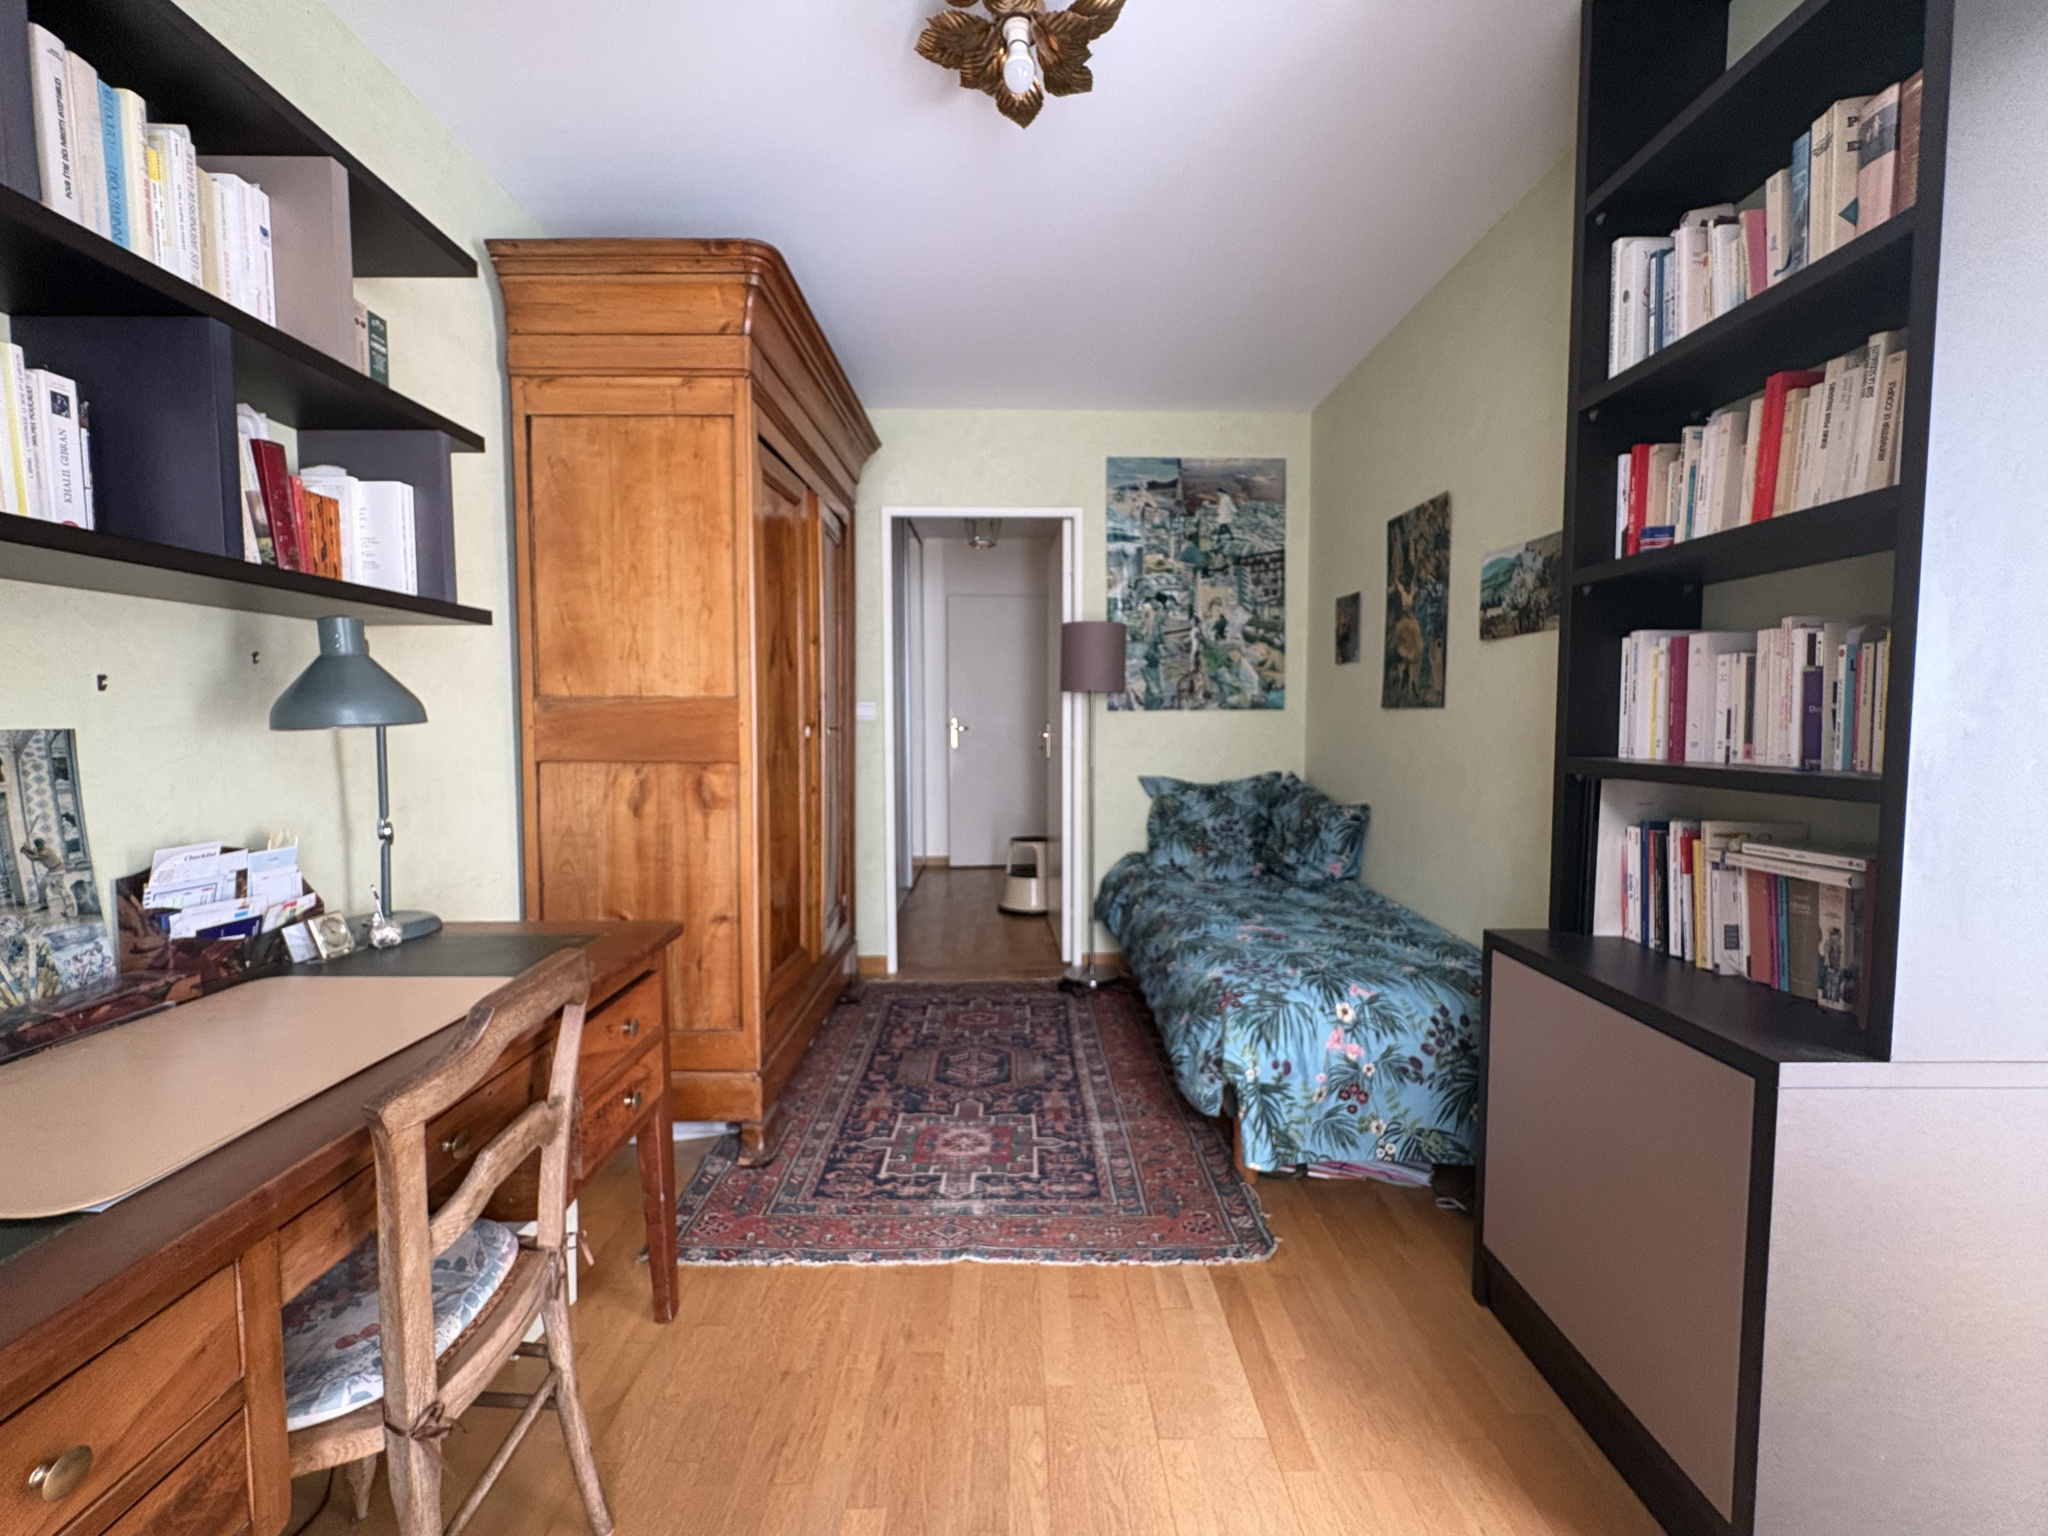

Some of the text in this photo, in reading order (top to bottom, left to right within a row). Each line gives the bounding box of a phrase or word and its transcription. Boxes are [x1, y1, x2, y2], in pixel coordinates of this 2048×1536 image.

[61, 148, 69, 161] DES
[189, 252, 200, 270] LES
[26, 384, 37, 421] FOUCAULT
[1885, 380, 1897, 411] COUPLE
[1823, 412, 1832, 428] POUR
[59, 427, 73, 504] KHALIL GIBRAN
[183, 850, 217, 862] Checklist
